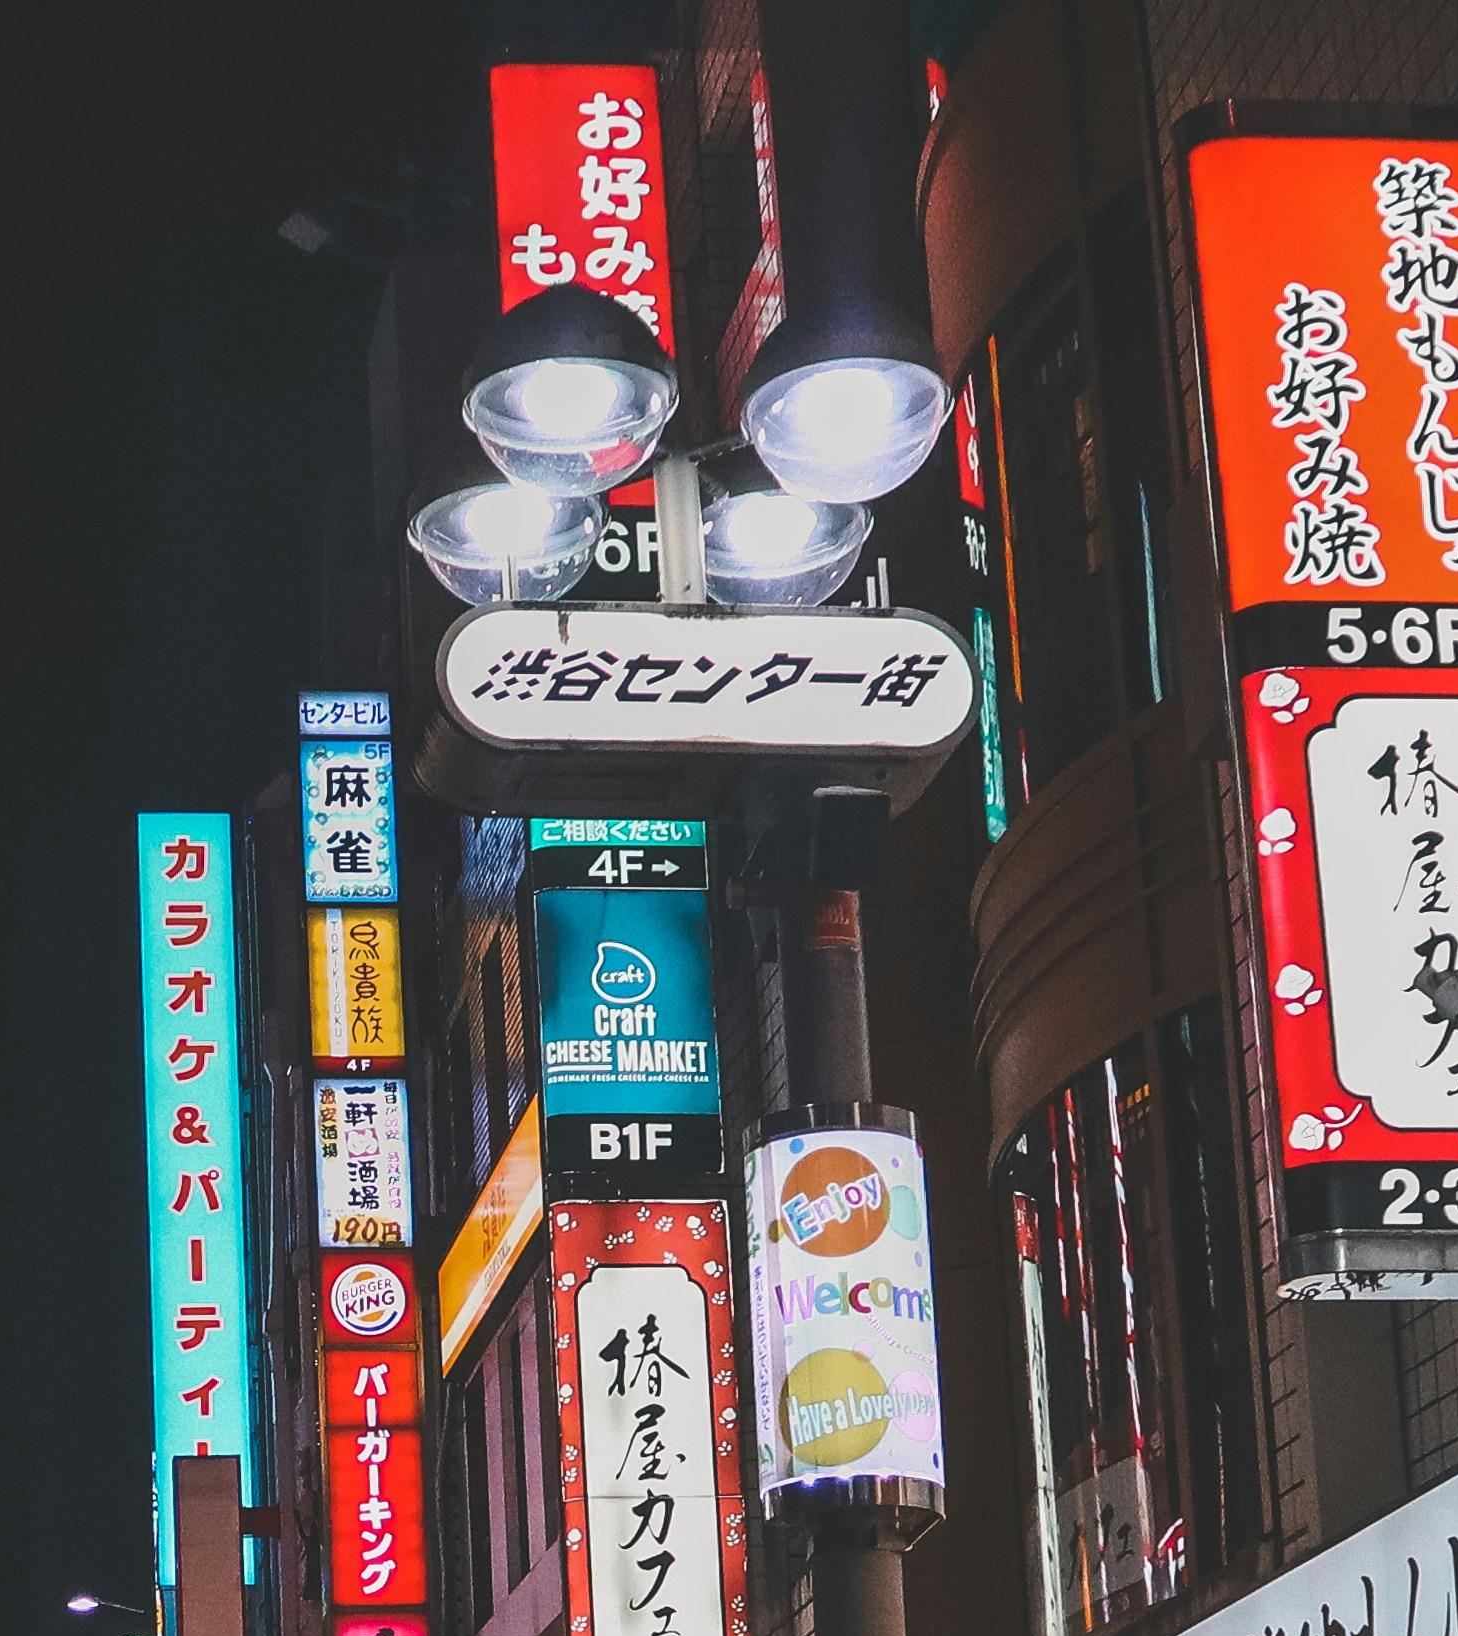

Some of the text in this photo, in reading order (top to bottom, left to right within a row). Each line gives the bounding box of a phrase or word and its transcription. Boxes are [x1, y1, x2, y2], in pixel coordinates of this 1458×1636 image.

[1268, 284, 1386, 585] お好み焼
[470, 646, 948, 710] 渋谷センター街
[300, 700, 390, 725] センタービル
[364, 743, 390, 760] 5F
[324, 764, 373, 874] 麻雀
[540, 819, 692, 843] ご相談ください
[588, 850, 645, 885] 4F
[600, 963, 646, 984] craft
[594, 1003, 657, 1037] Craft
[346, 1058, 371, 1071] 4F
[546, 1040, 708, 1073] CHEESE MARKET
[162, 837, 224, 1456] カラオケ&パーティ
[589, 1122, 673, 1161] B1F
[781, 1171, 884, 1247] Enjoy
[341, 1278, 394, 1302] BURGER
[345, 1290, 396, 1320] KING
[774, 1270, 935, 1326] Welcome
[788, 1394, 833, 1448] Have
[835, 1399, 850, 1431] a
[848, 1386, 908, 1429] Lovely
[353, 1363, 397, 1596] バーガーキング
